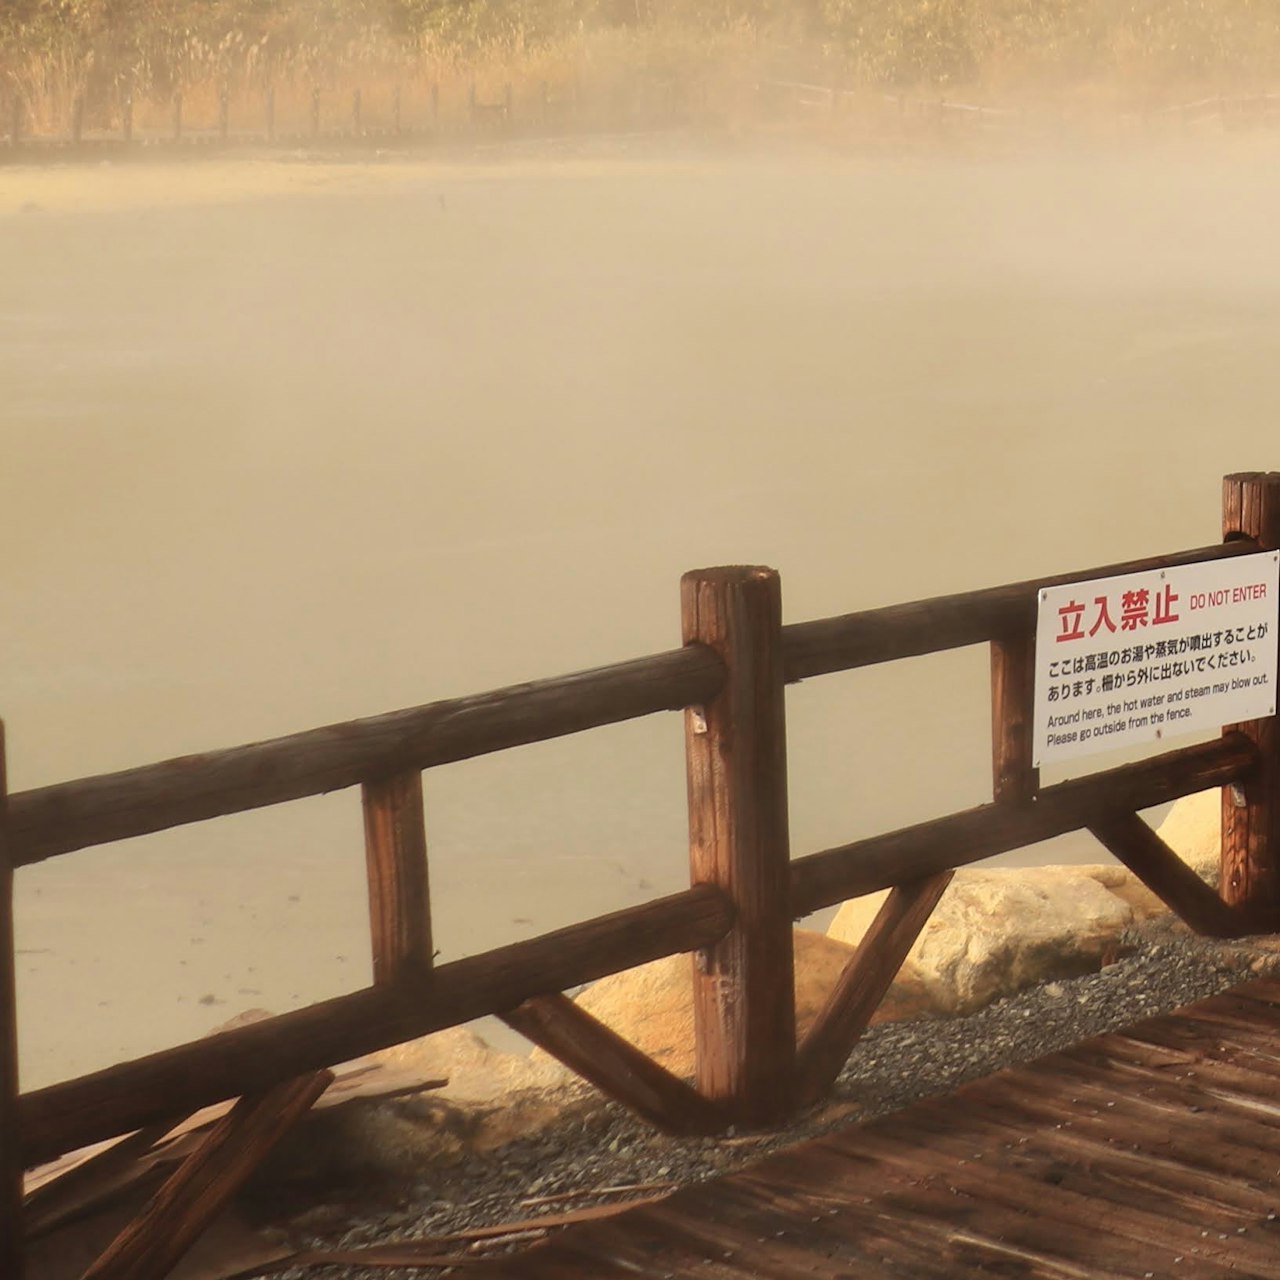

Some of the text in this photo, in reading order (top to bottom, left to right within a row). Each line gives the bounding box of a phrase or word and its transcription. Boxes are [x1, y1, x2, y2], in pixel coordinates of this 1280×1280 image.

[1056, 584, 1179, 642] 立入禁止
[1190, 584, 1266, 610] DO NOT ENTER
[1048, 649, 1256, 702] あります。柵から外に出ないでください。
[1049, 622, 1268, 678] ここは高温のお湯や蒸気が噴出することが
[1047, 706, 1192, 747] Please go outside from the fence.
[1048, 674, 1268, 728] Around here, the hot water and steam may blow out.
